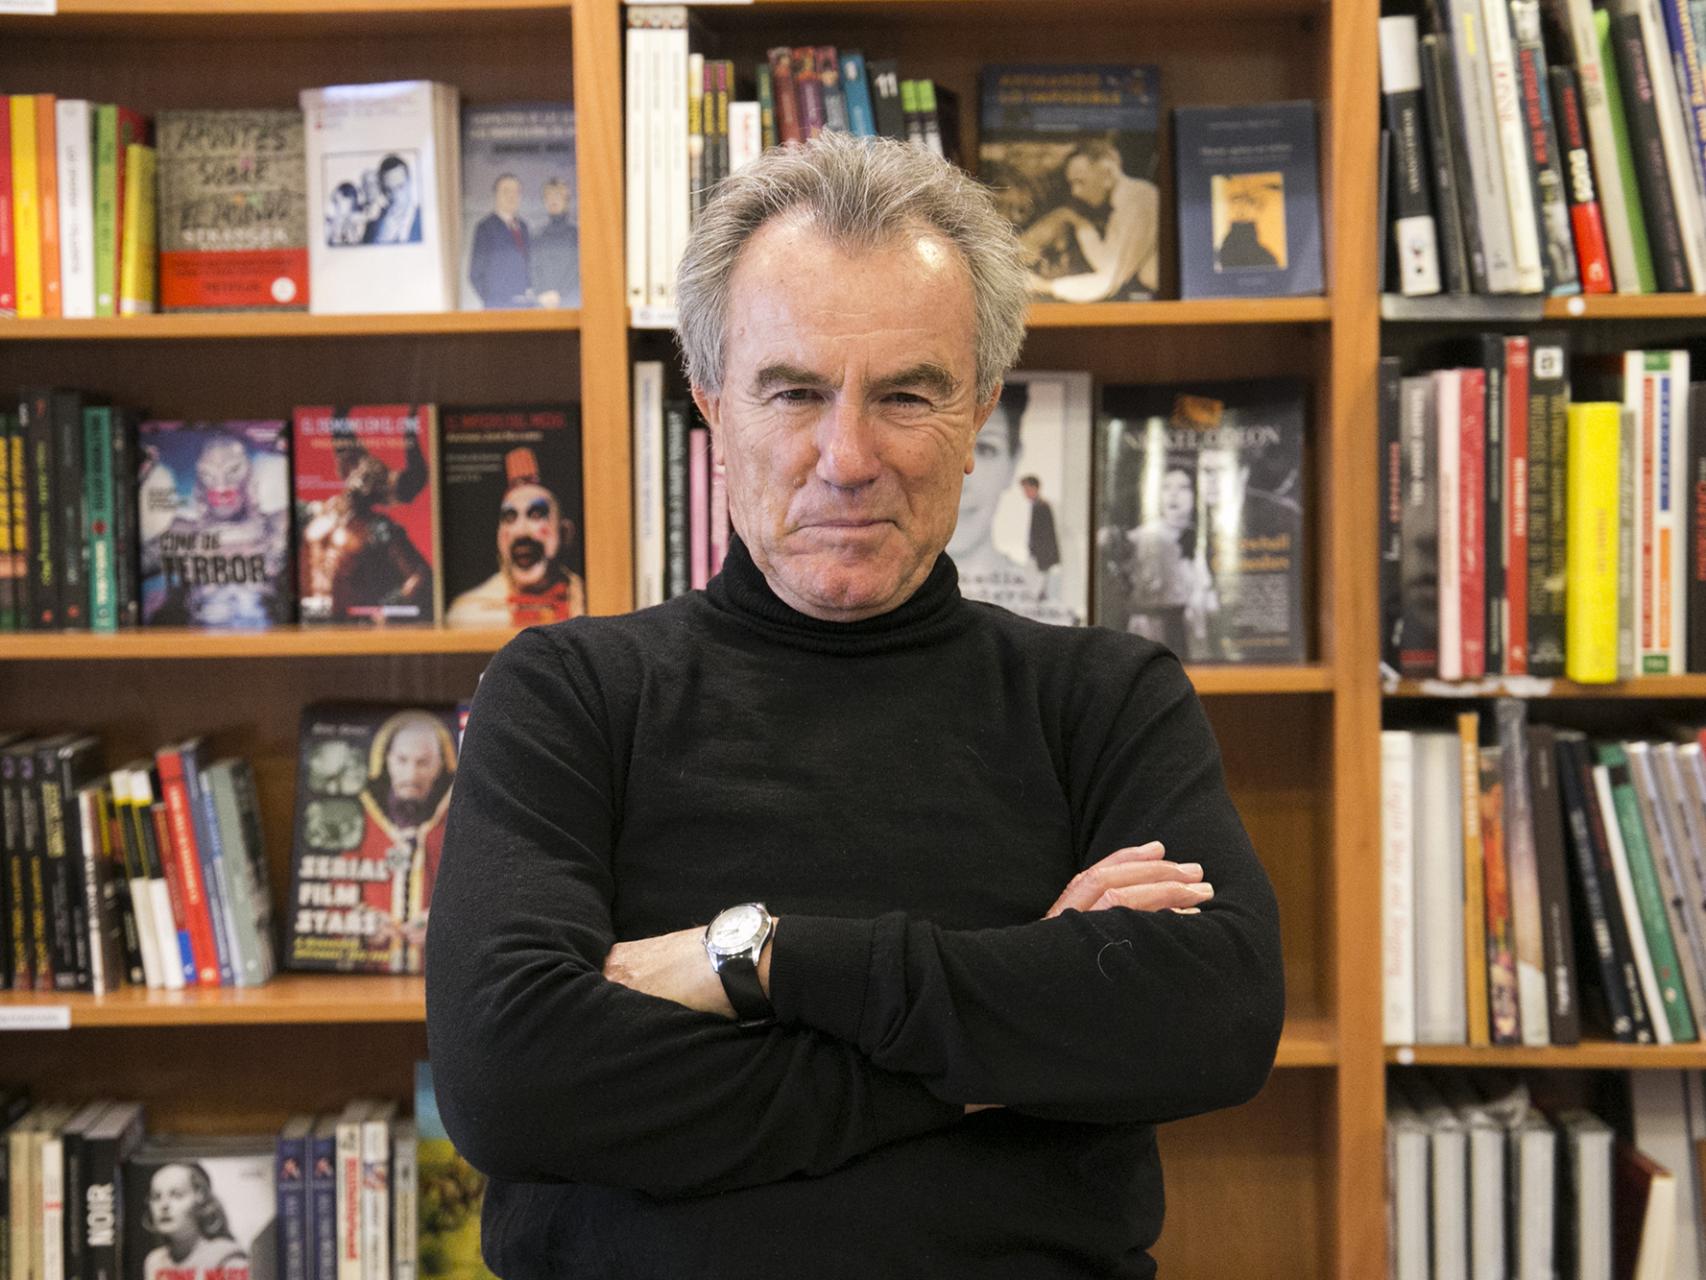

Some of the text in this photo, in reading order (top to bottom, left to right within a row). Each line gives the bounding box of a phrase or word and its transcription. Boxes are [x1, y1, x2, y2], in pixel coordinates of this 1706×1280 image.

[162, 554, 268, 584] TERROR
[299, 854, 390, 880] SERIAL
[298, 882, 361, 906] FILM
[294, 908, 376, 934] STARS
[86, 1183, 115, 1246] NOIR
